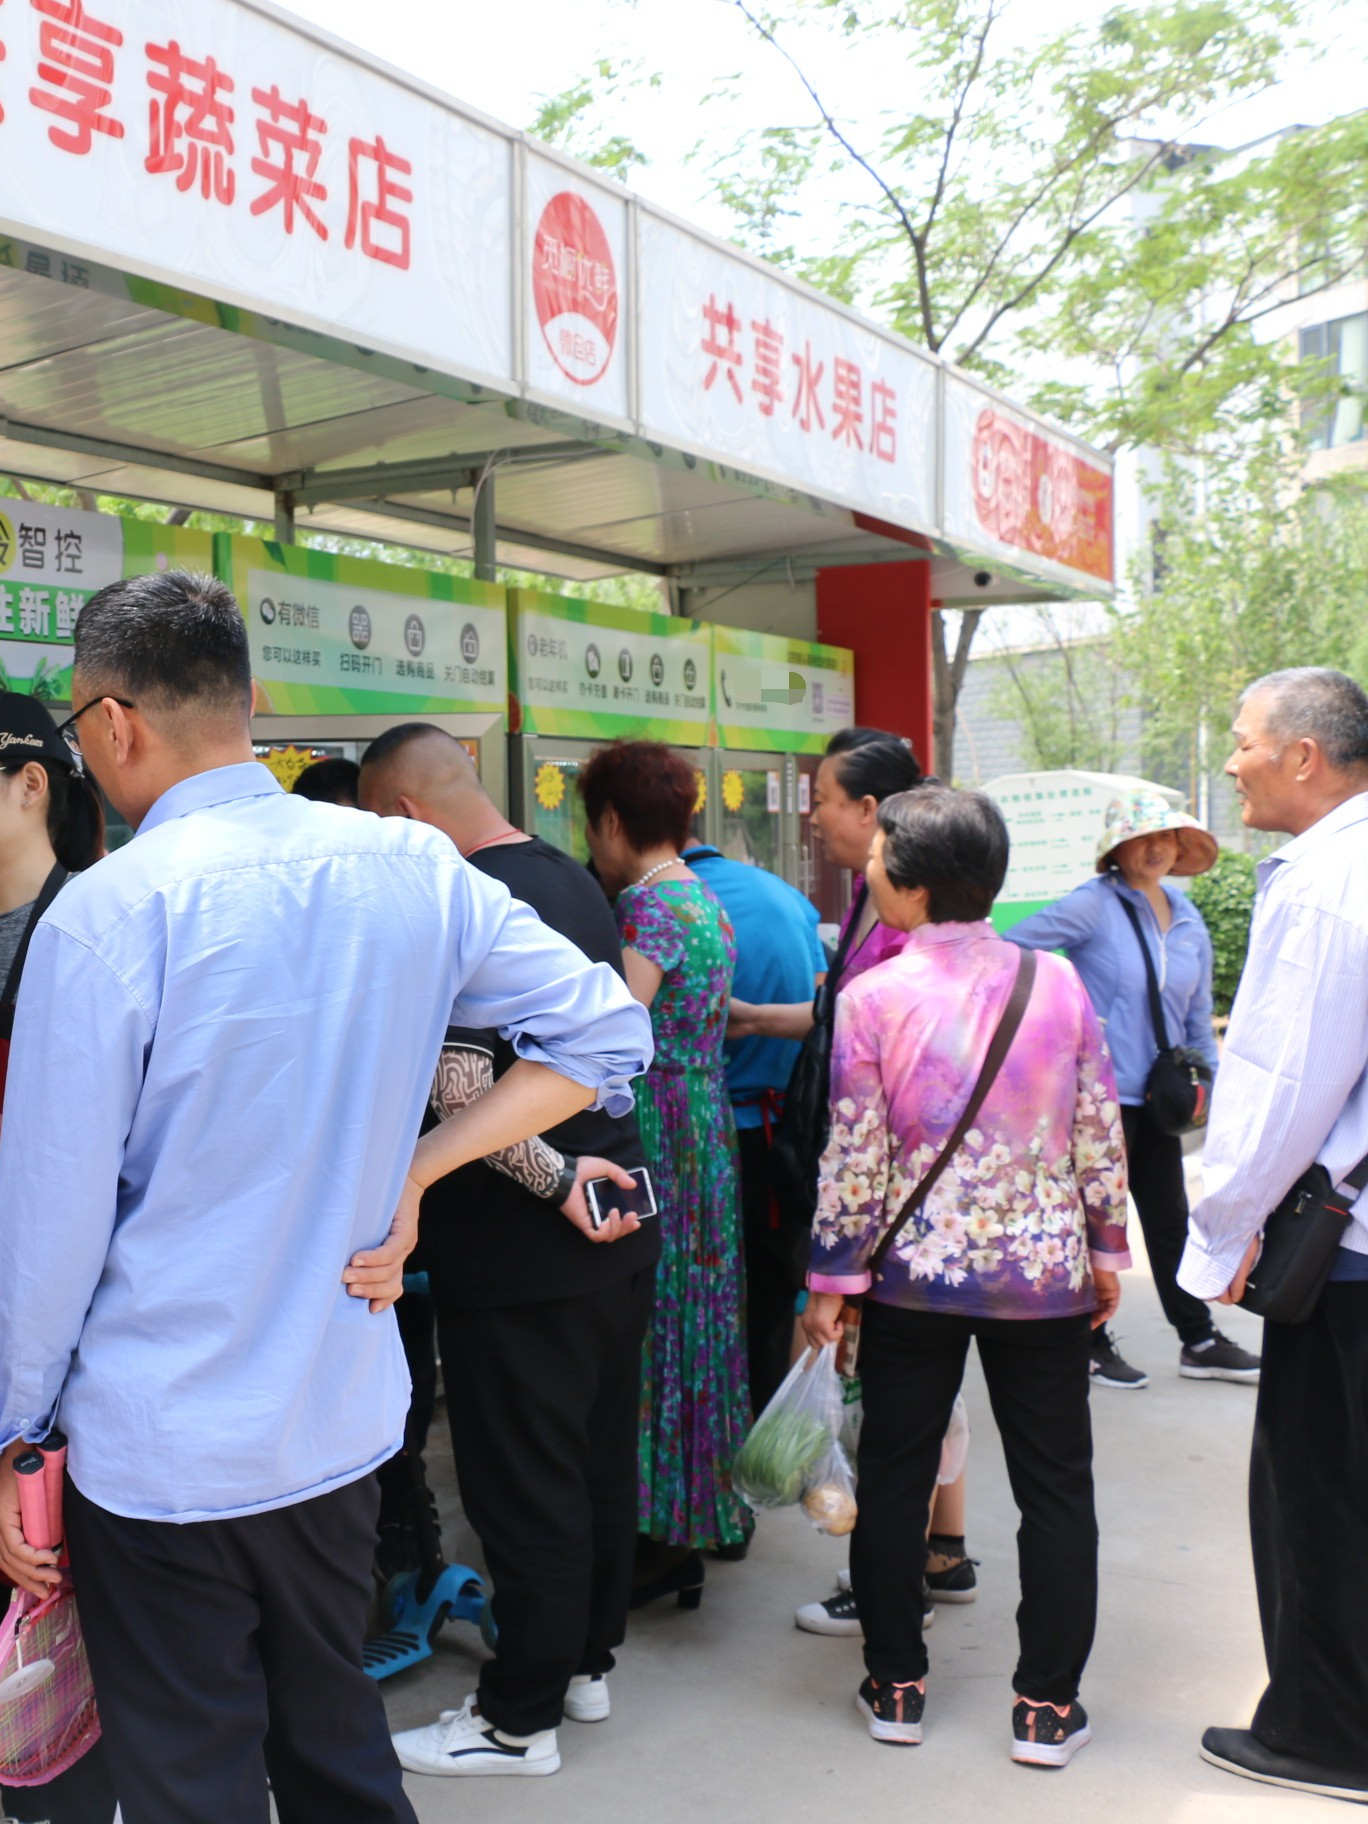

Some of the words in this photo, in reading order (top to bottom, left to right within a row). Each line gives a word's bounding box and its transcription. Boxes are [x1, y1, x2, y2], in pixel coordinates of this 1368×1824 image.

[700, 292, 898, 465] 共享水果店
[278, 600, 321, 629] 有微信
[262, 645, 321, 667] 您可以这样买
[339, 652, 383, 675] 扫码开门
